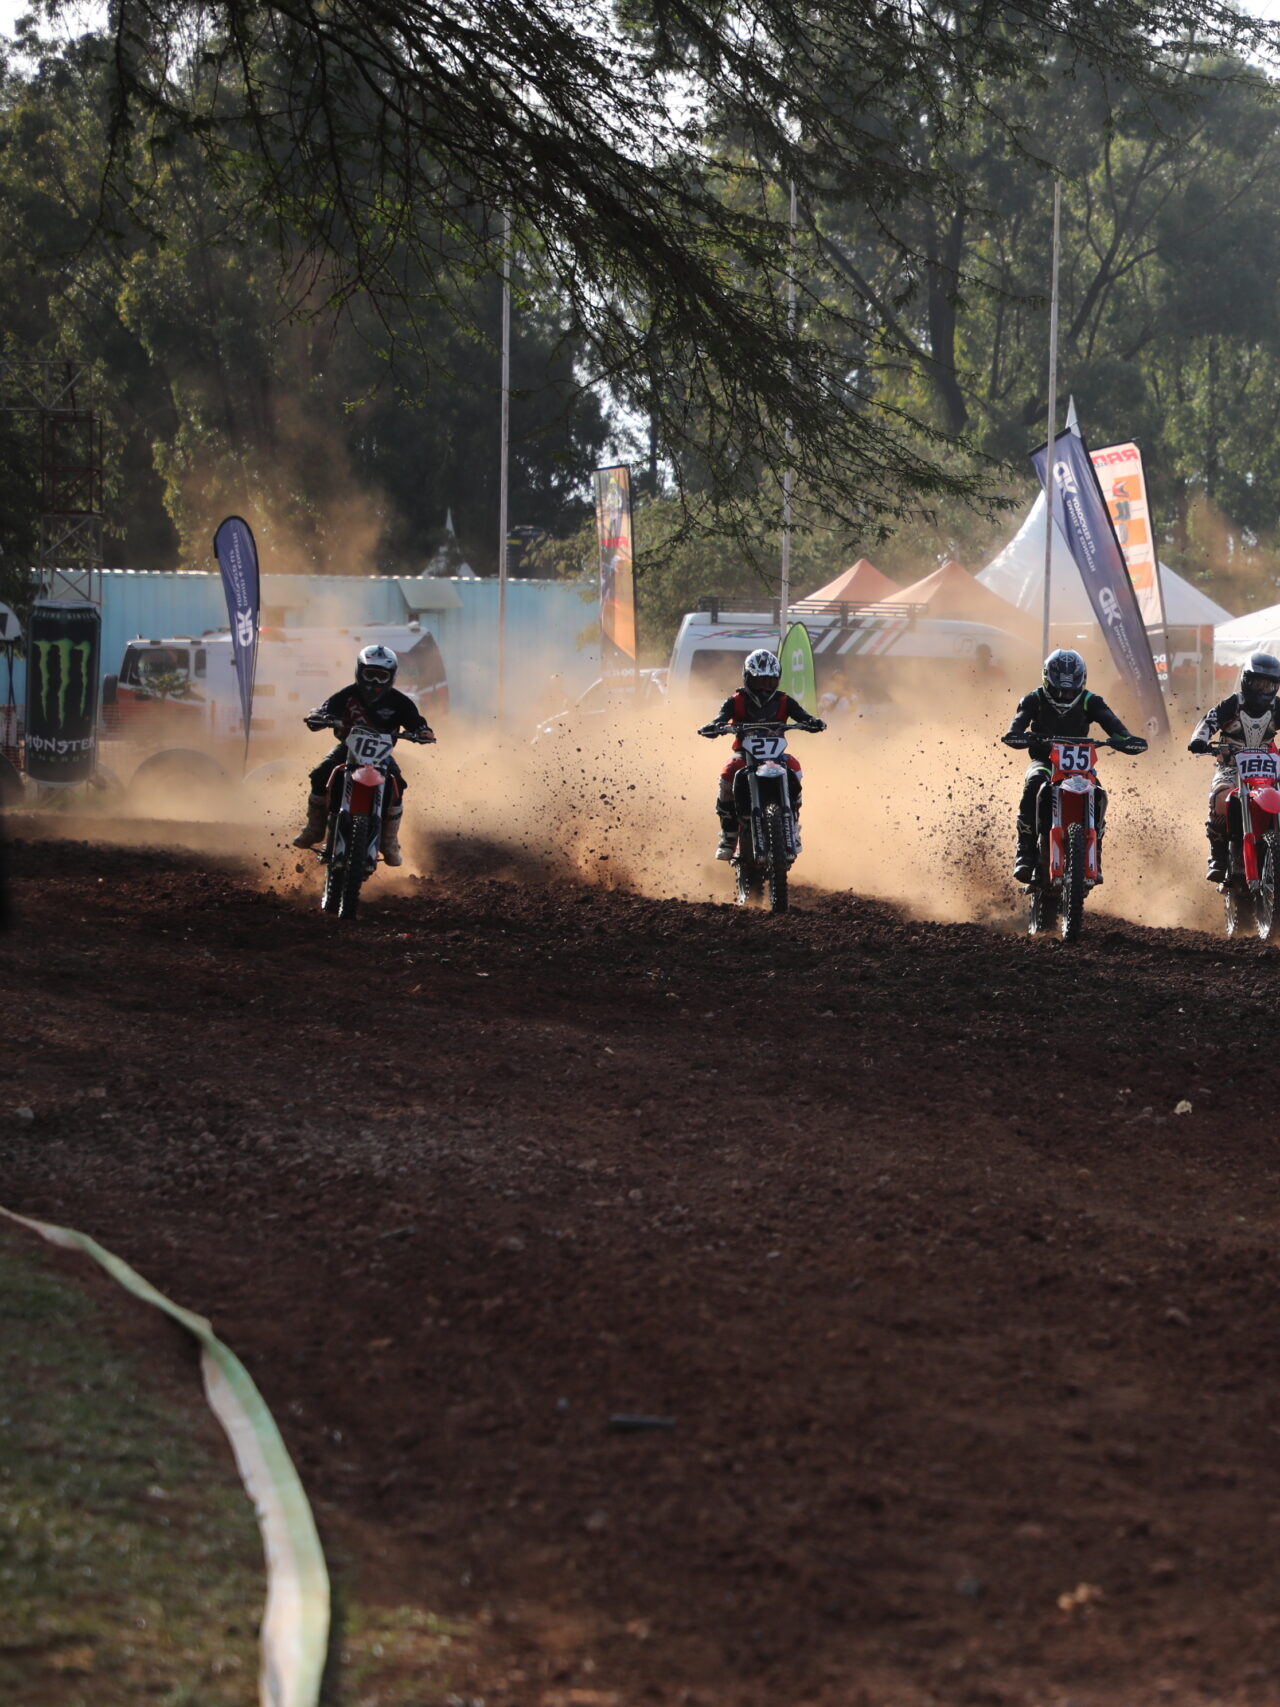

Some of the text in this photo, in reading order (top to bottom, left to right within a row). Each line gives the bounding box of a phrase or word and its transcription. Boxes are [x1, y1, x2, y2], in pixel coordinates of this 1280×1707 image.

[25, 733, 95, 754] MONSTER
[355, 737, 392, 759] 167
[751, 739, 779, 755] 27
[1061, 746, 1089, 770] 55
[1240, 759, 1277, 774] 188
